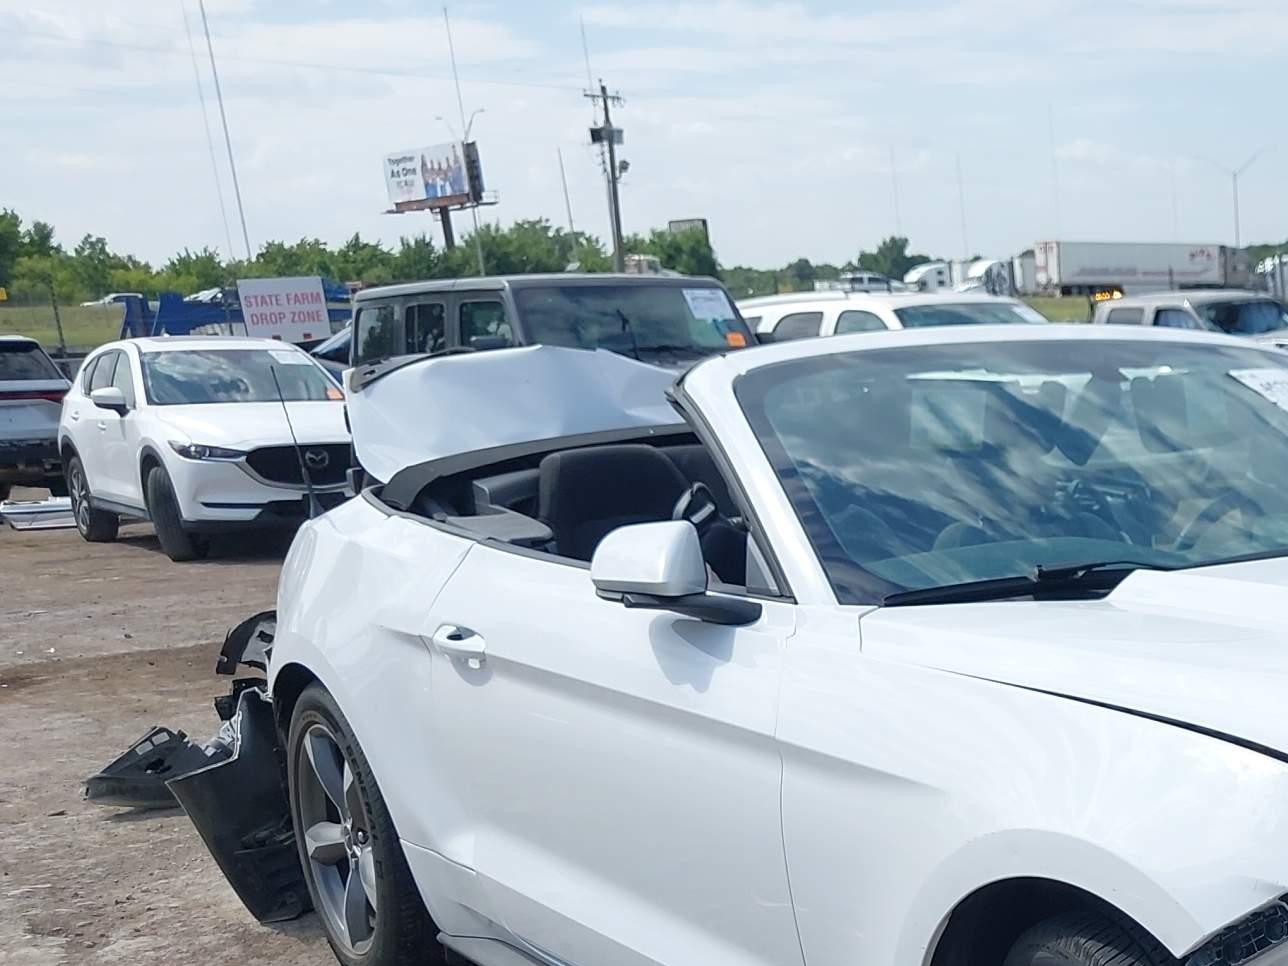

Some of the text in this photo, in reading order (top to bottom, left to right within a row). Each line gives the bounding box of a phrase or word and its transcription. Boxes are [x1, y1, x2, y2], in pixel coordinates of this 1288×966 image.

[391, 167, 417, 178] As One
[244, 292, 322, 308] STATE FARM
[251, 310, 323, 325] DROP ZONE
[346, 743, 379, 842] GENERAL
